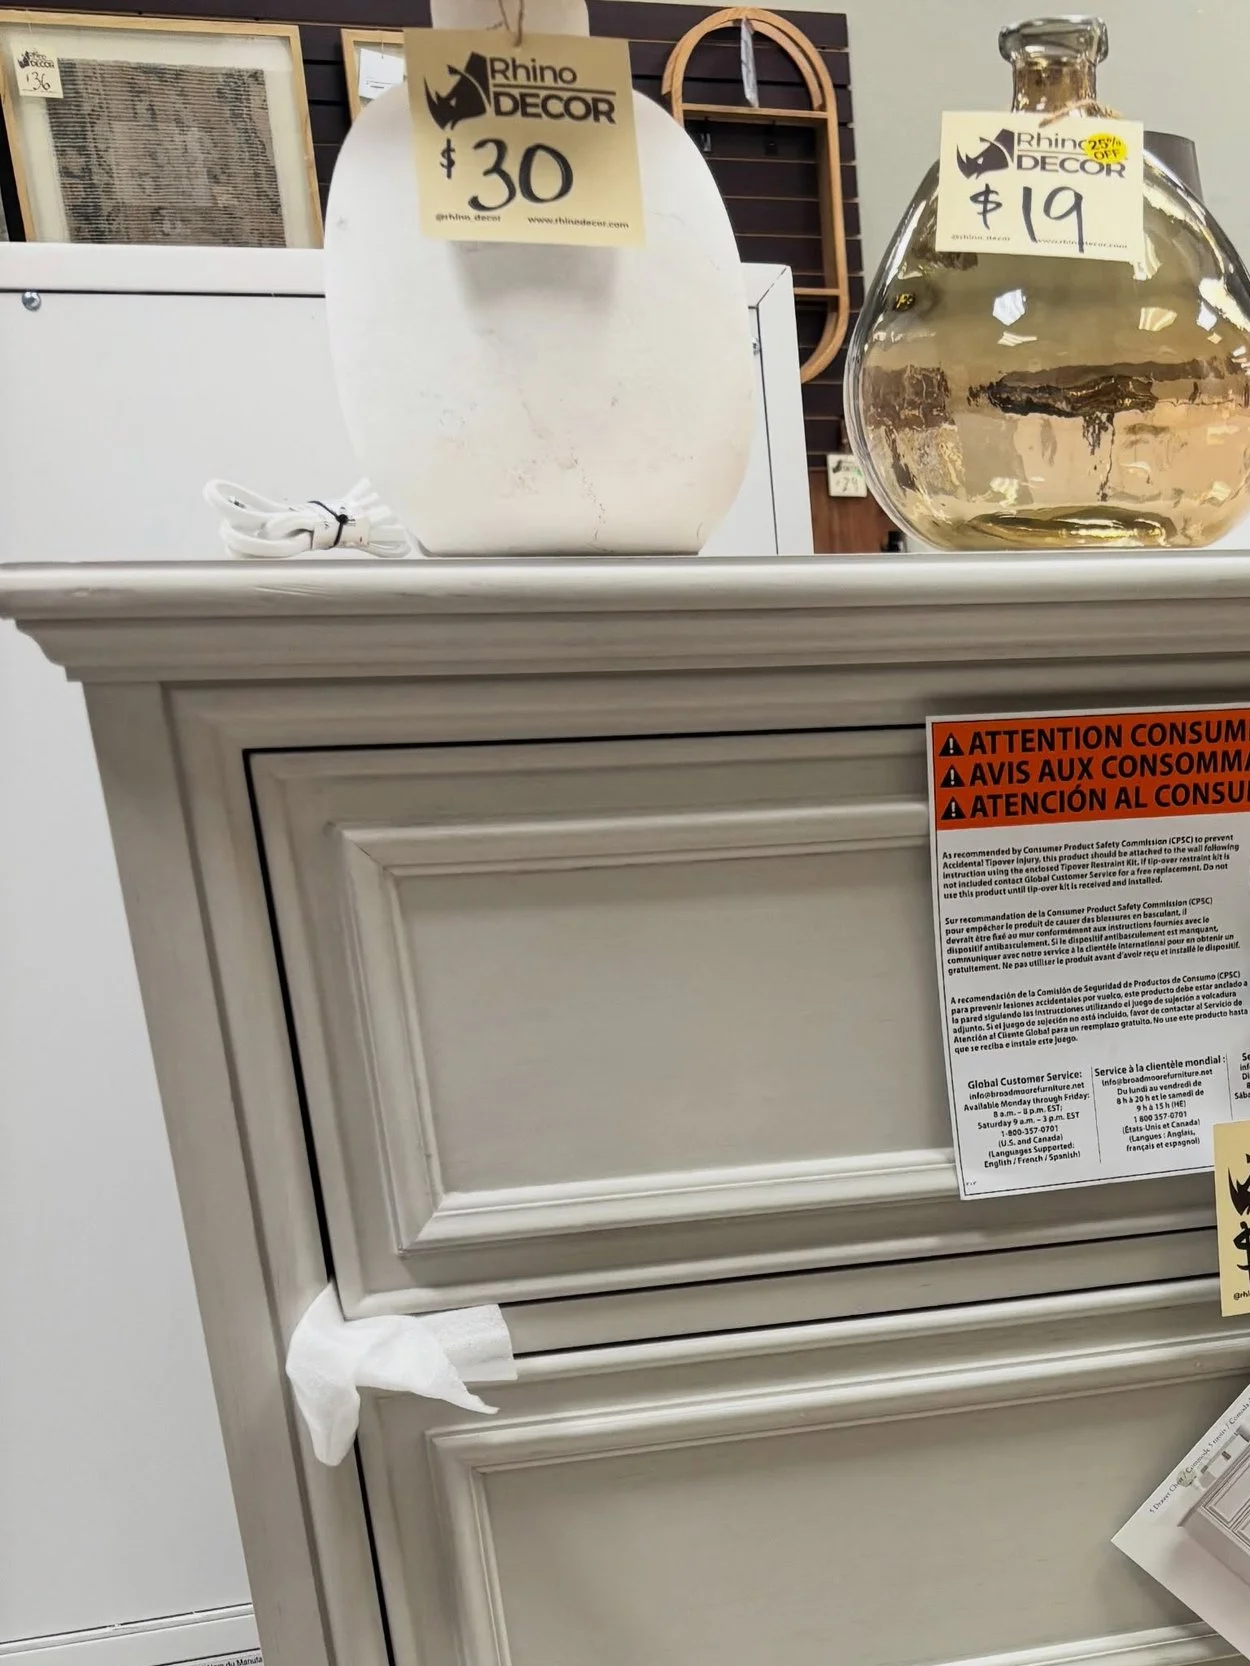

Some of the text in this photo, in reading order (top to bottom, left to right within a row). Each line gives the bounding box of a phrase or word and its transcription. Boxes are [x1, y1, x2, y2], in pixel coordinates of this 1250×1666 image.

[489, 57, 577, 85] Rhino
[494, 92, 616, 125] DECOR
[1017, 154, 1126, 178] DECOR
[1094, 150, 1120, 160] OFF
[528, 215, 629, 229] www.rhinodecor.com
[969, 725, 1122, 755] ATTENTION
[970, 760, 1030, 786] AVIS
[1038, 757, 1094, 782] AUX
[970, 784, 1106, 818] ATENCIÓN
[1114, 786, 1147, 809] AL
[943, 859, 984, 869] Accidental
[985, 859, 1015, 867] Tipover
[1058, 853, 1089, 863] product
[1091, 850, 1116, 859] should
[1129, 847, 1162, 856] attached
[1187, 845, 1203, 853] wall
[1204, 843, 1239, 852] following
[954, 848, 1010, 858] recommended
[1012, 847, 1022, 856] by
[1023, 846, 1062, 854] Consumer
[1096, 841, 1120, 849] Safety
[1121, 839, 1167, 847] Commission
[1169, 836, 1193, 844] (CPSC)
[1204, 835, 1233, 844] prevent
[958, 879, 992, 888] included
[1024, 875, 1049, 883] Global
[1051, 873, 1088, 881] Customer
[1153, 865, 1201, 875] replacement.
[1094, 1067, 1127, 1077] Service
[1129, 1065, 1134, 1073] à
[1136, 1064, 1144, 1072] la
[1146, 1060, 1183, 1071] clientèle
[1185, 1055, 1221, 1067] mondial
[968, 1071, 1082, 1089] Global Customer Service:
[964, 1092, 1089, 1111] Available Monday through Friday:
[984, 1157, 1012, 1168] English
[1017, 1155, 1043, 1164] French
[1048, 1151, 1080, 1161] Spanish)
[988, 1142, 1074, 1158] (Languages Supported:
